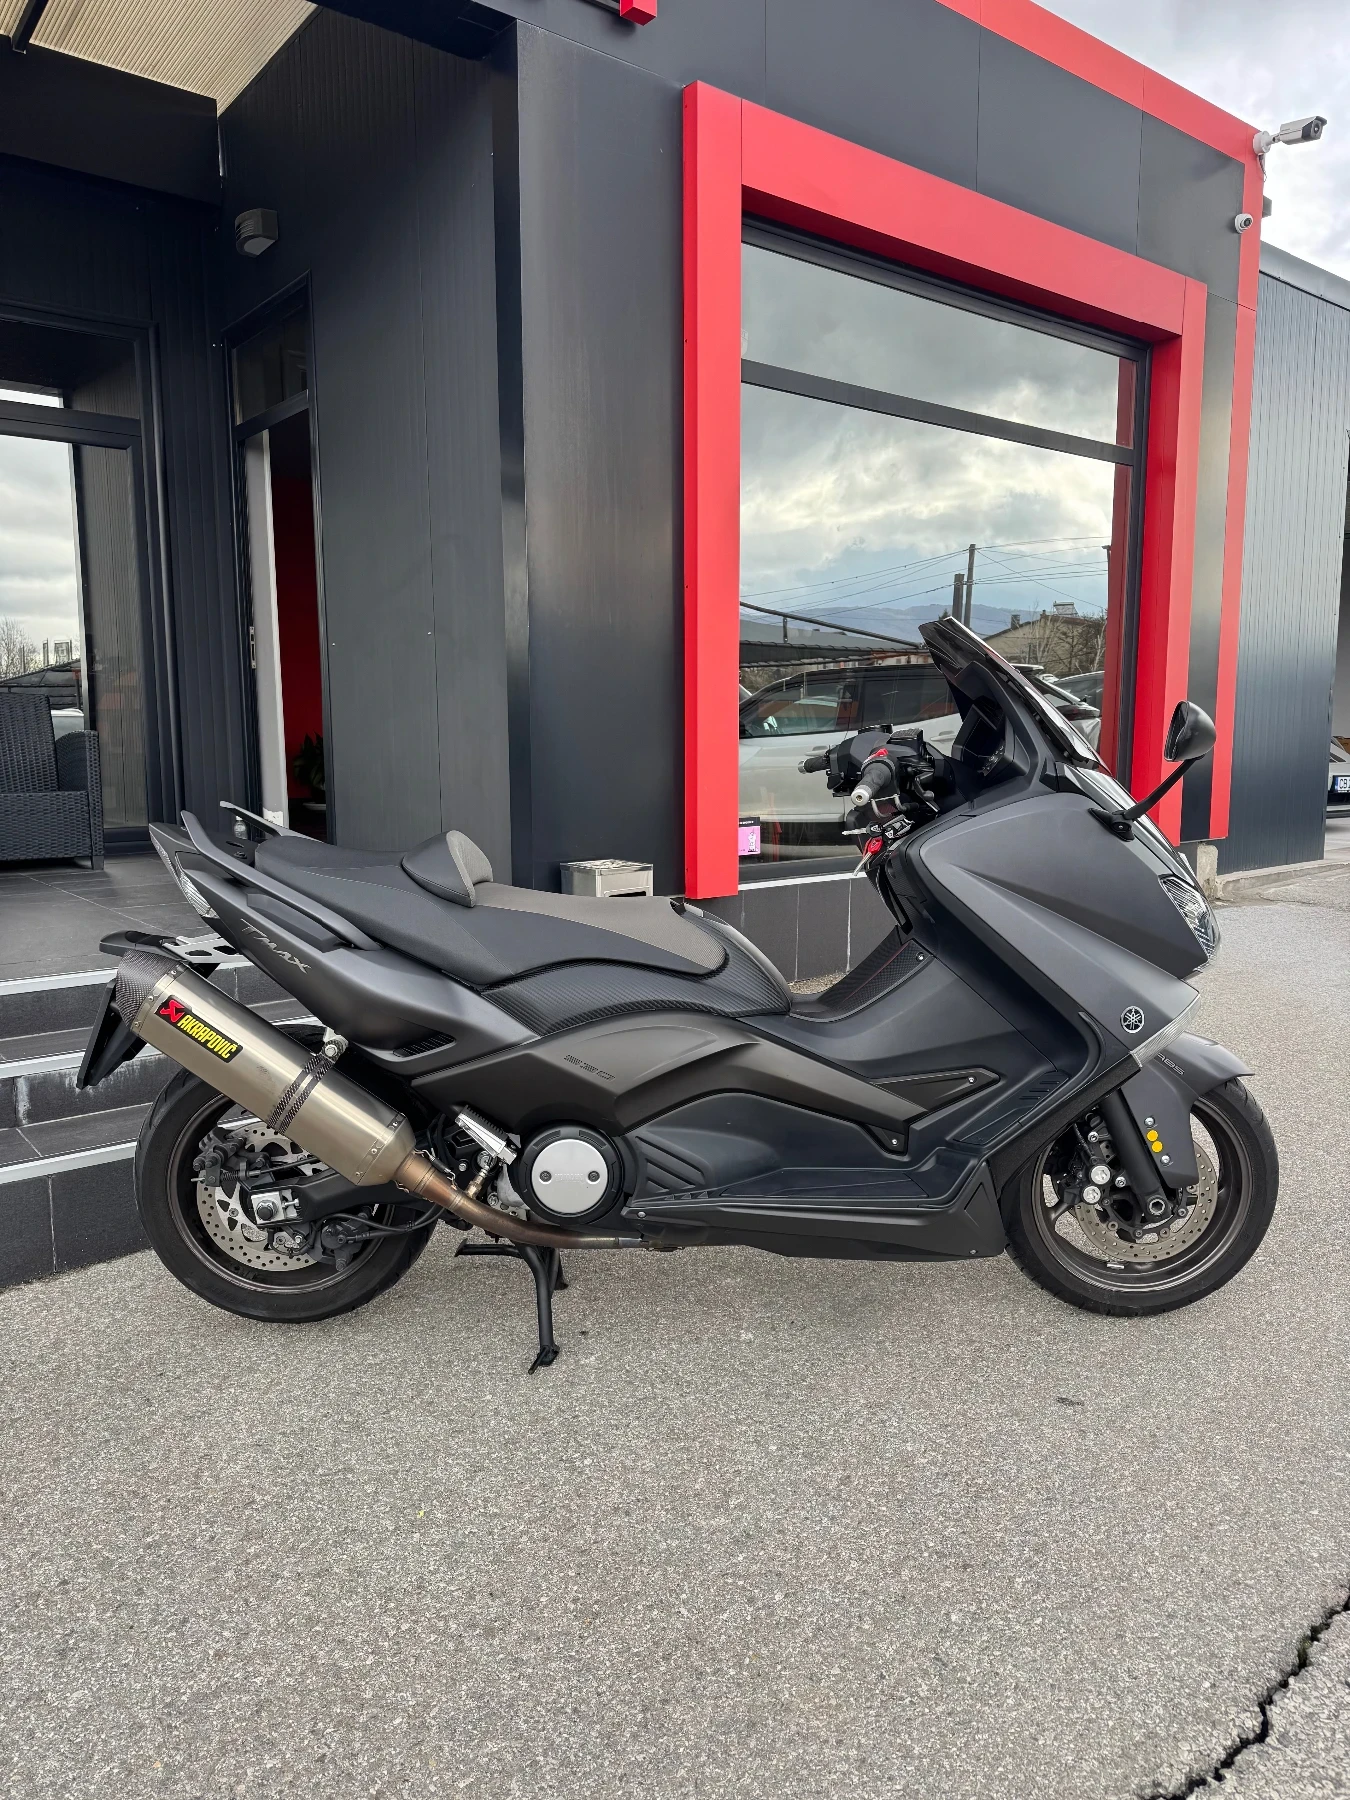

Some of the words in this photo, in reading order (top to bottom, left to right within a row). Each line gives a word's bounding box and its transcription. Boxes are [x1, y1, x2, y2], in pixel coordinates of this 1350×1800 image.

[240, 918, 312, 974] TMAX
[177, 1014, 239, 1059] AKRAPOVIČ
[1157, 1052, 1185, 1076] ABS
